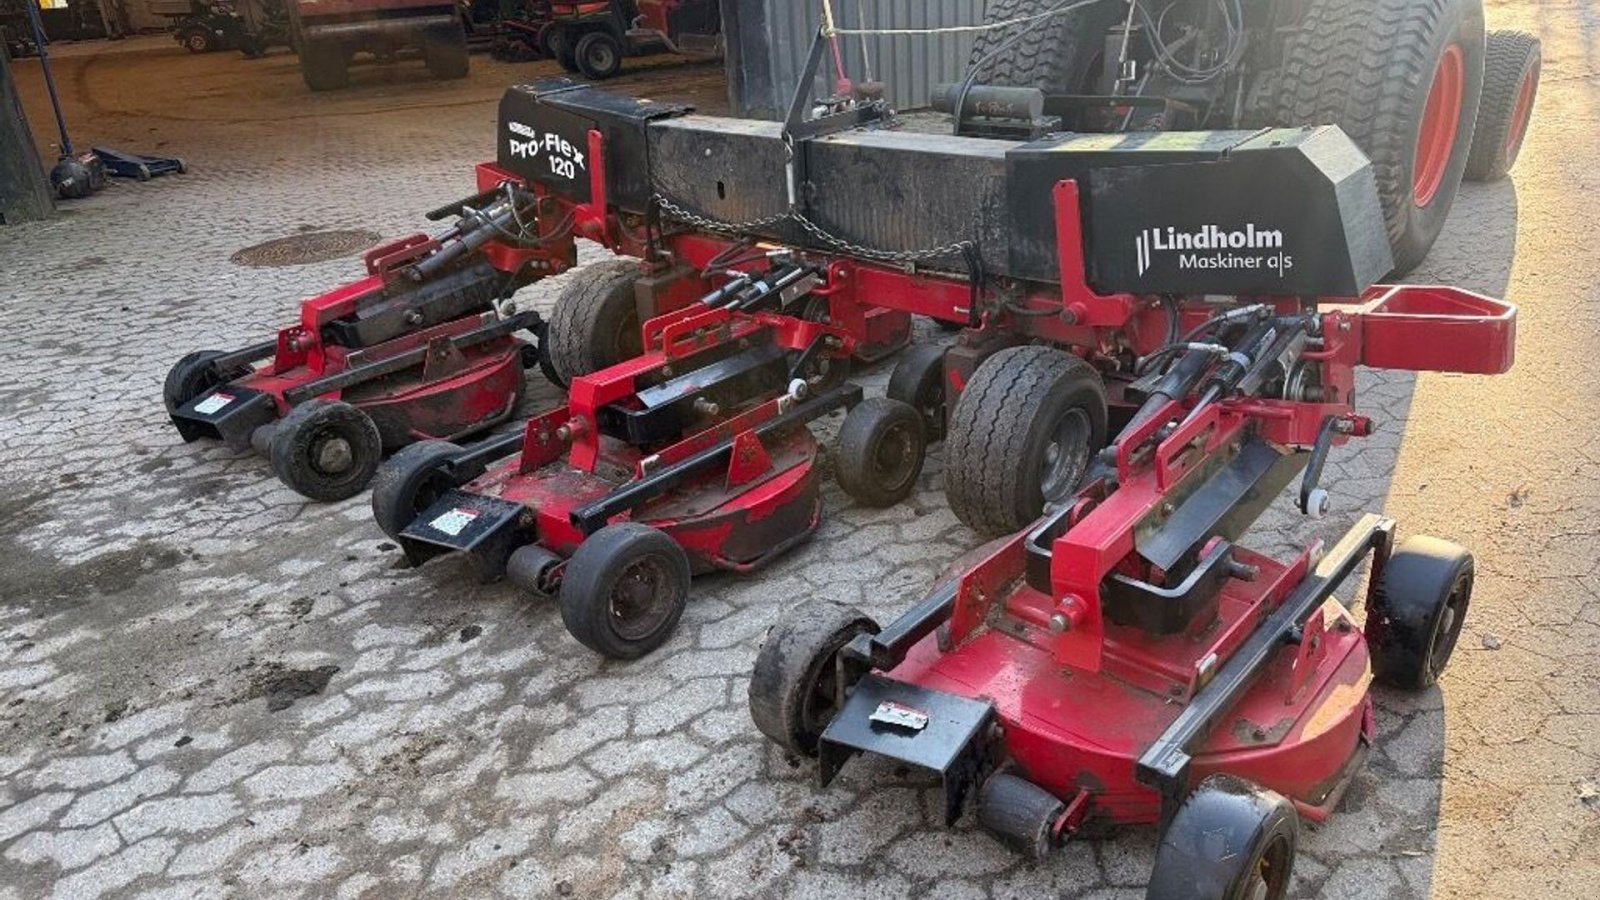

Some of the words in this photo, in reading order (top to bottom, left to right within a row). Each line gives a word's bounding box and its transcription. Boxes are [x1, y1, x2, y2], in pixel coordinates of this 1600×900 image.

[548, 154, 575, 180] 120
[1152, 223, 1283, 250] Lindholm
[1179, 253, 1263, 269] Maskiner
